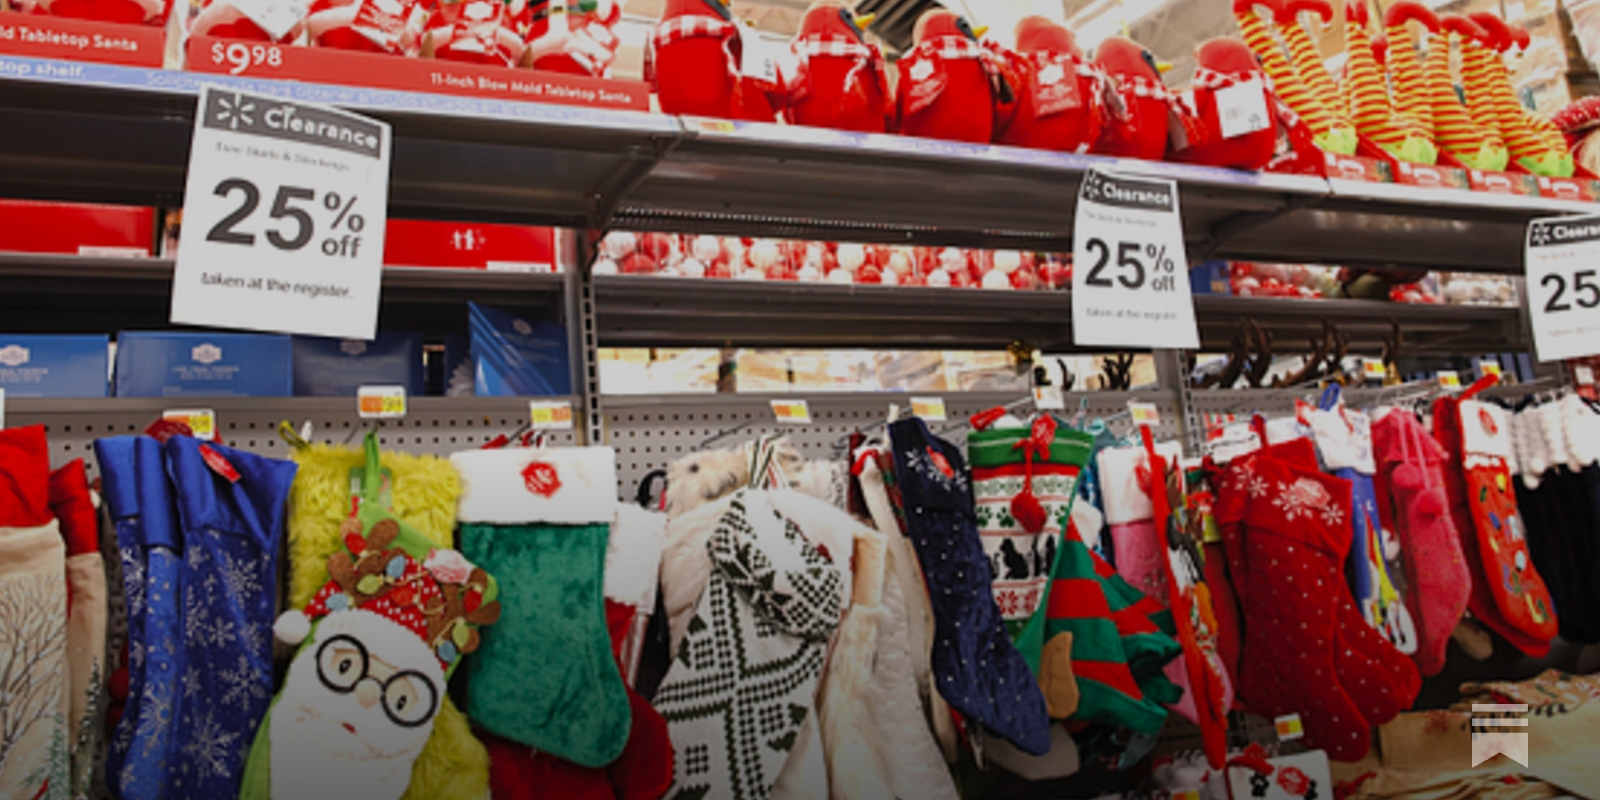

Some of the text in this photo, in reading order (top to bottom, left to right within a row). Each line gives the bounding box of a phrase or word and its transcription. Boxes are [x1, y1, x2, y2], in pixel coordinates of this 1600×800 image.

[18, 26, 89, 50] Tabletop
[93, 34, 138, 51] Santa
[478, 77, 508, 91] Blow
[511, 81, 543, 95] Mold
[545, 84, 596, 102] Tabletop
[598, 90, 632, 103] Santa
[264, 105, 378, 149] Clearance
[1103, 182, 1170, 206] Clearance
[321, 235, 362, 258] off
[201, 272, 245, 288] taken
[247, 277, 263, 291] at
[266, 278, 291, 293] the
[1152, 275, 1175, 291] off
[1540, 269, 1600, 314] 25
